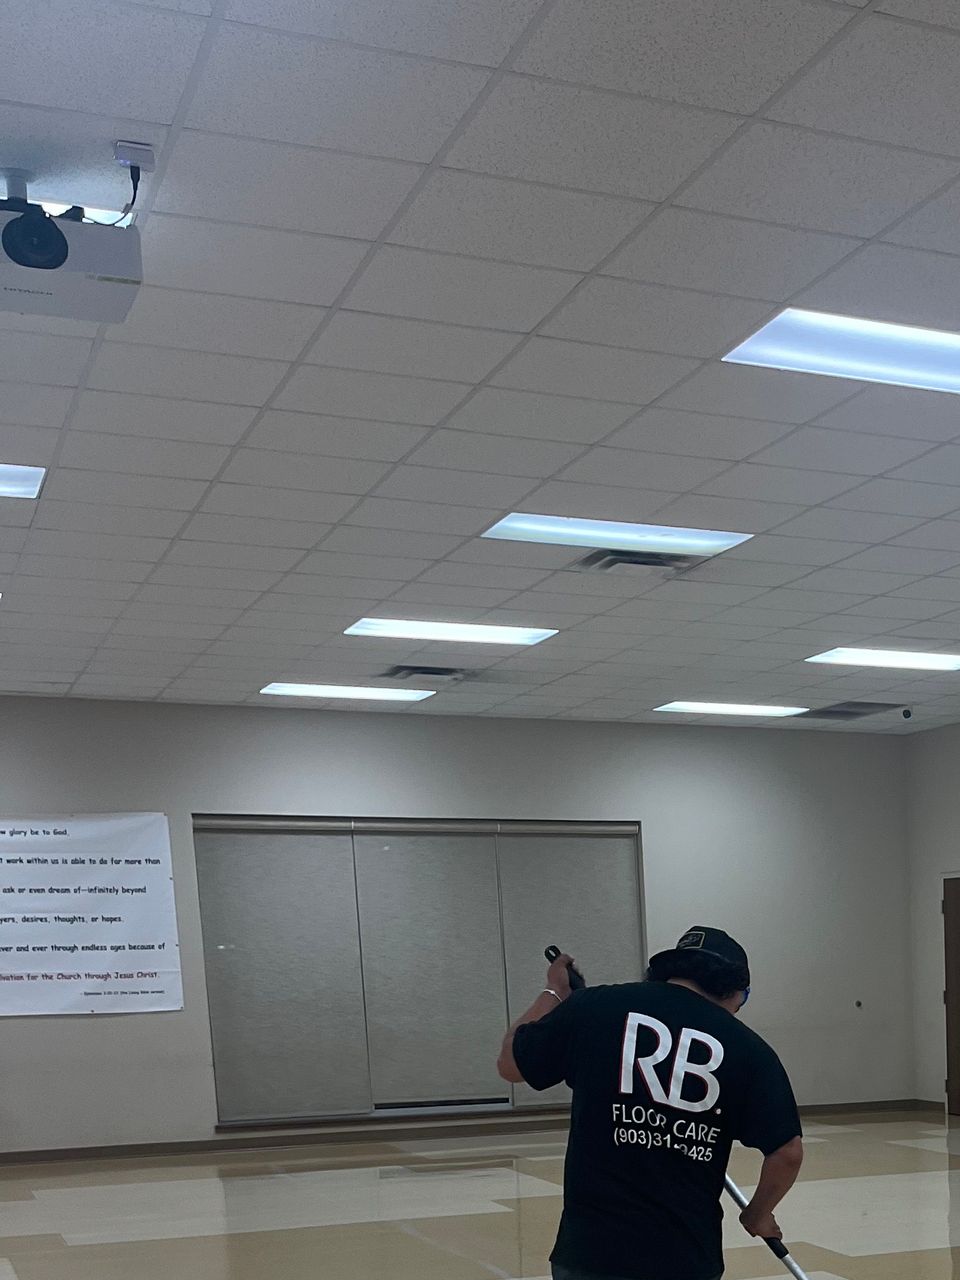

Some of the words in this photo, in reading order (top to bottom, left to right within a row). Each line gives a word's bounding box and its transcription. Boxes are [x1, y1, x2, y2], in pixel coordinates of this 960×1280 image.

[9, 828, 27, 837] glory
[27, 857, 49, 865] within
[62, 857, 68, 865] is
[71, 857, 86, 865] able
[99, 857, 108, 865] do
[2, 886, 15, 894] ask
[48, 886, 71, 894] dream
[121, 885, 147, 895] beyond
[51, 944, 78, 953] through
[128, 942, 155, 950] because
[158, 942, 165, 950] of
[57, 972, 82, 980] Church
[85, 972, 112, 981] through
[114, 971, 134, 979] Jesus
[612, 1103, 667, 1129] FLOOR
[673, 1119, 721, 1144] CARE
